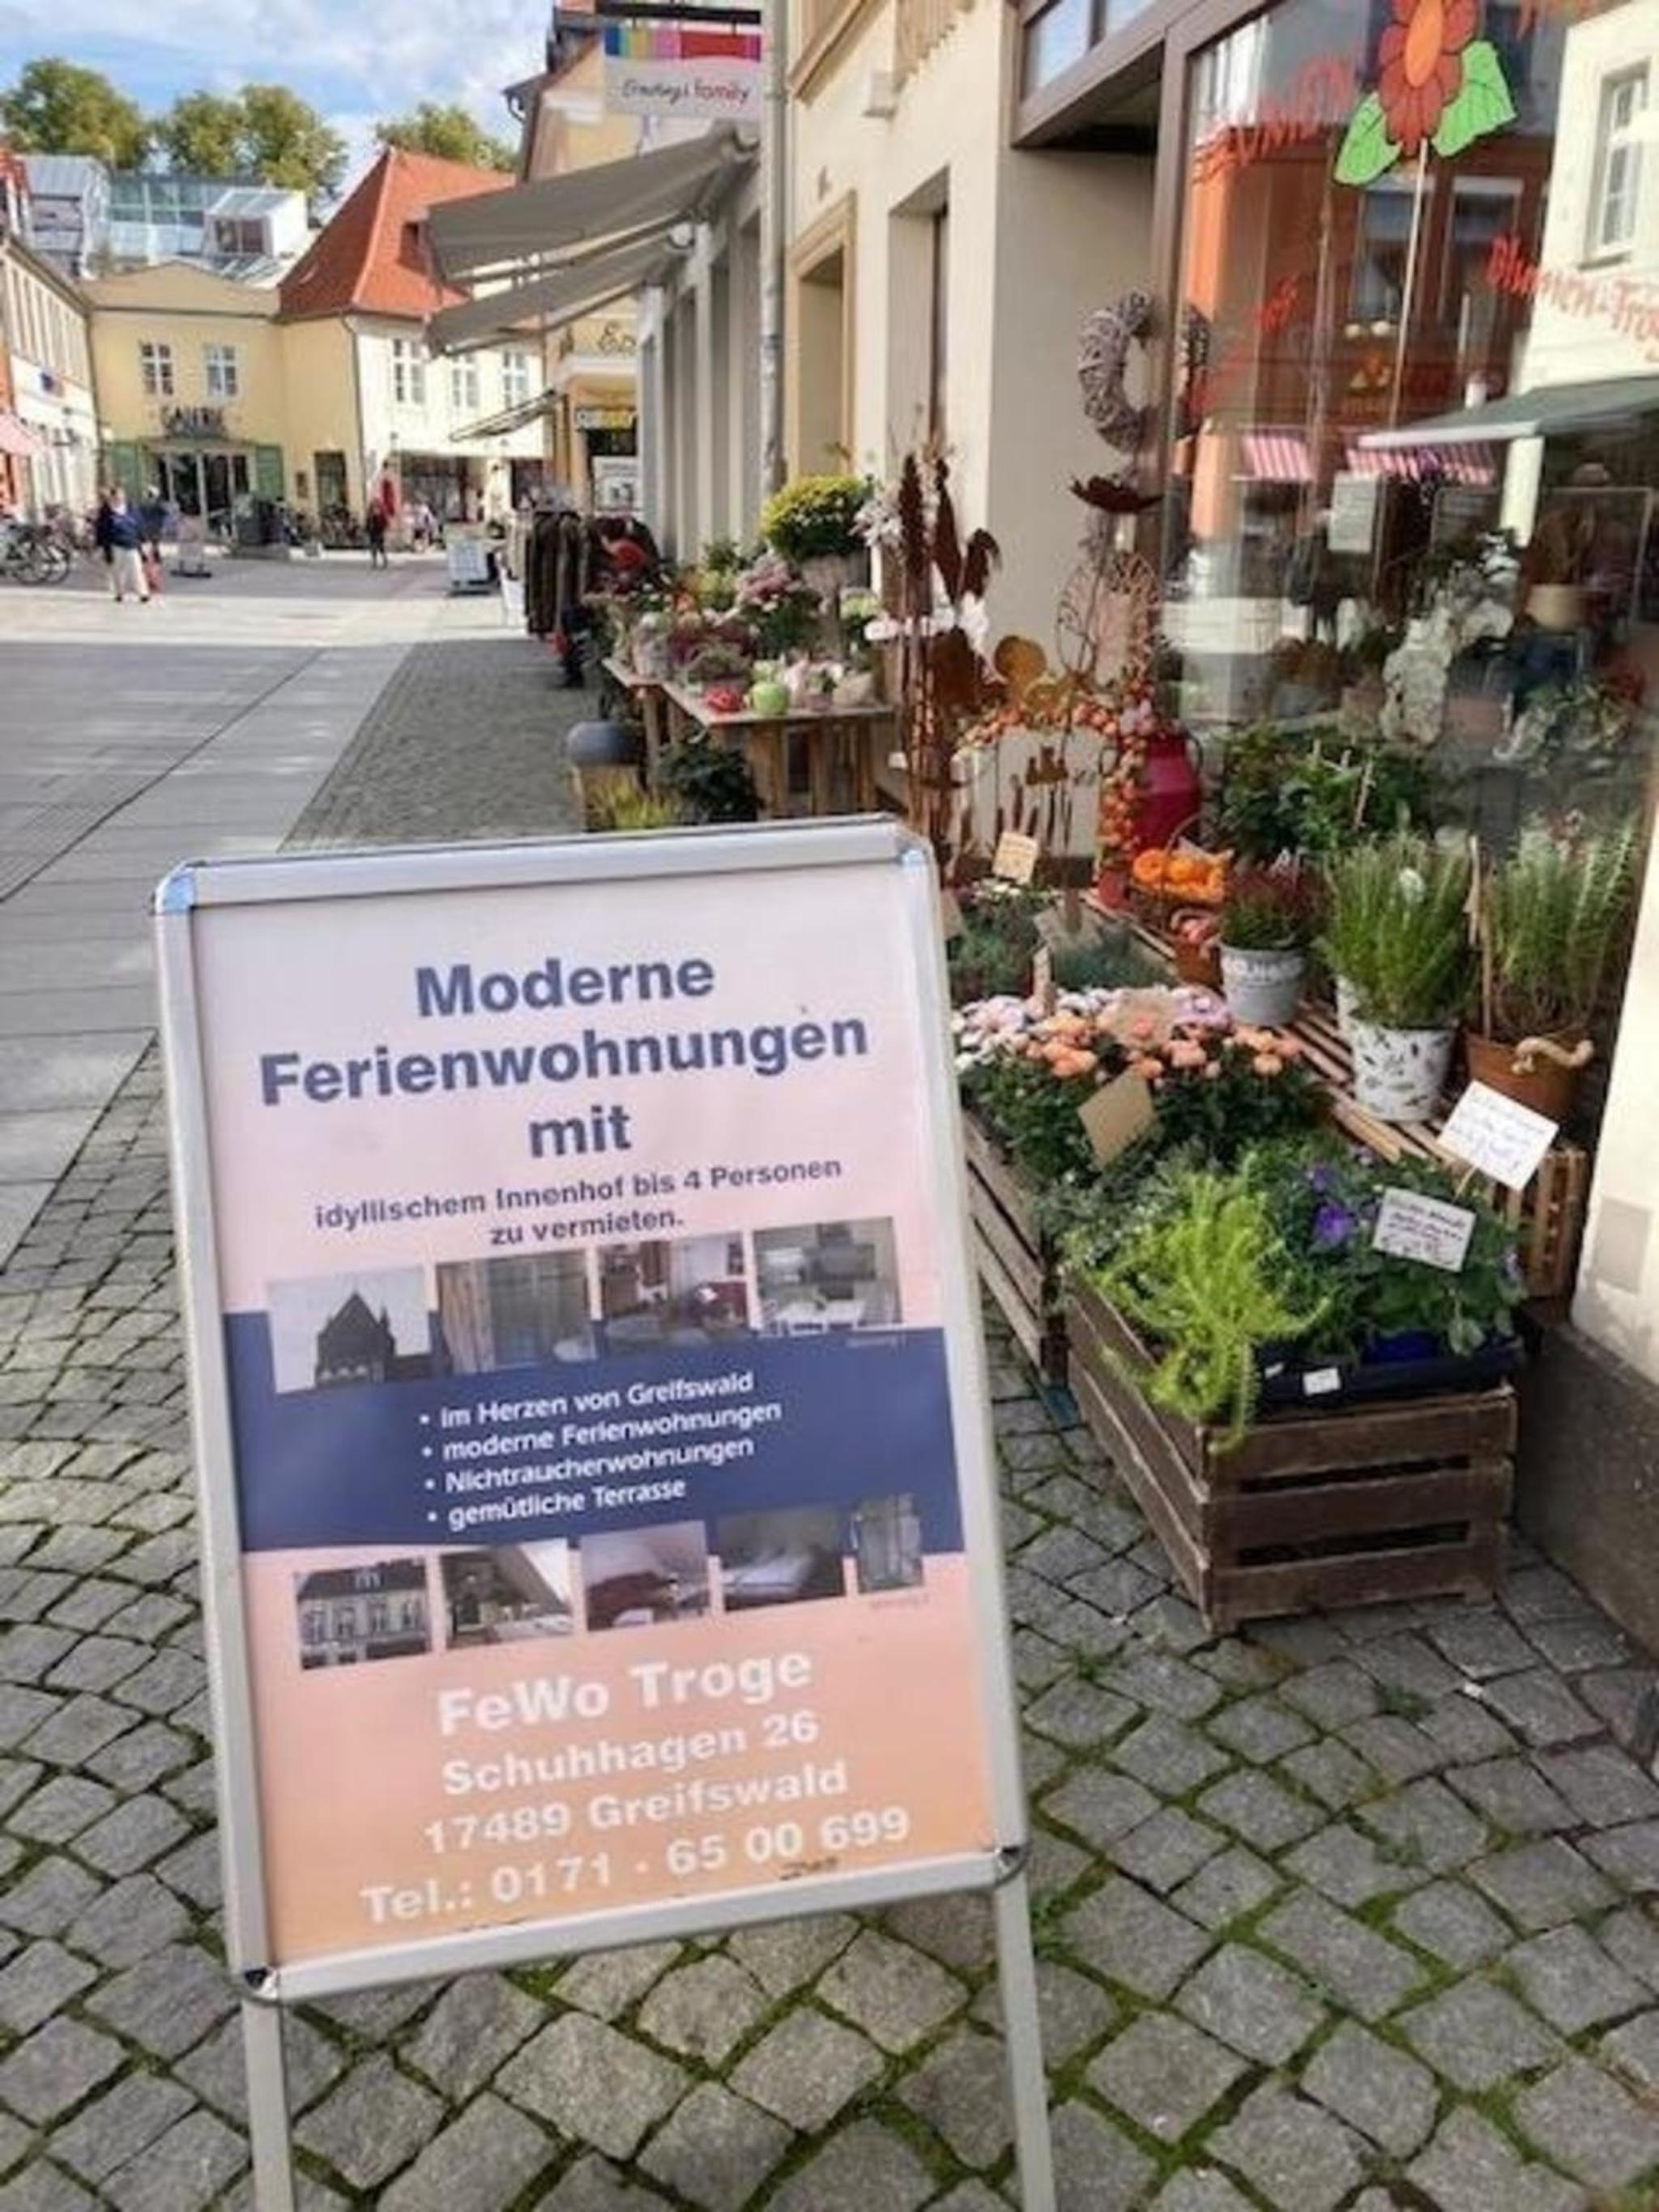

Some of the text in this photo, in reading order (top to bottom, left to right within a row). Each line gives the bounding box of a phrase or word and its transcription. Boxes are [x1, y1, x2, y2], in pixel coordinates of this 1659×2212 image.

[416, 957, 714, 1017] Moderne
[259, 1017, 869, 1106] Ferienwohnungen
[528, 1105, 632, 1158] mit
[315, 1157, 843, 1231] idyllischem Innenhof bis 4 Personen
[490, 1208, 684, 1247] zu vermieten.
[478, 1396, 568, 1425] Herzen
[574, 1391, 621, 1412] von
[628, 1372, 754, 1406] Greifswald
[441, 1401, 782, 1460] moderne Ferienwohnungen
[445, 1437, 754, 1492] Nichtraucherwohnungen
[448, 1479, 686, 1531] gemütliche Terrasse
[437, 1651, 812, 1737] FeWo Troge
[442, 1711, 818, 1795] Schuhhagen 26
[424, 1760, 848, 1854] 17489 Greifswald
[360, 1878, 472, 1924] Tel.:
[492, 1852, 611, 1903] 0171
[666, 1835, 727, 1875] 65
[744, 1823, 804, 1863] 00
[820, 1807, 911, 1850] 699
